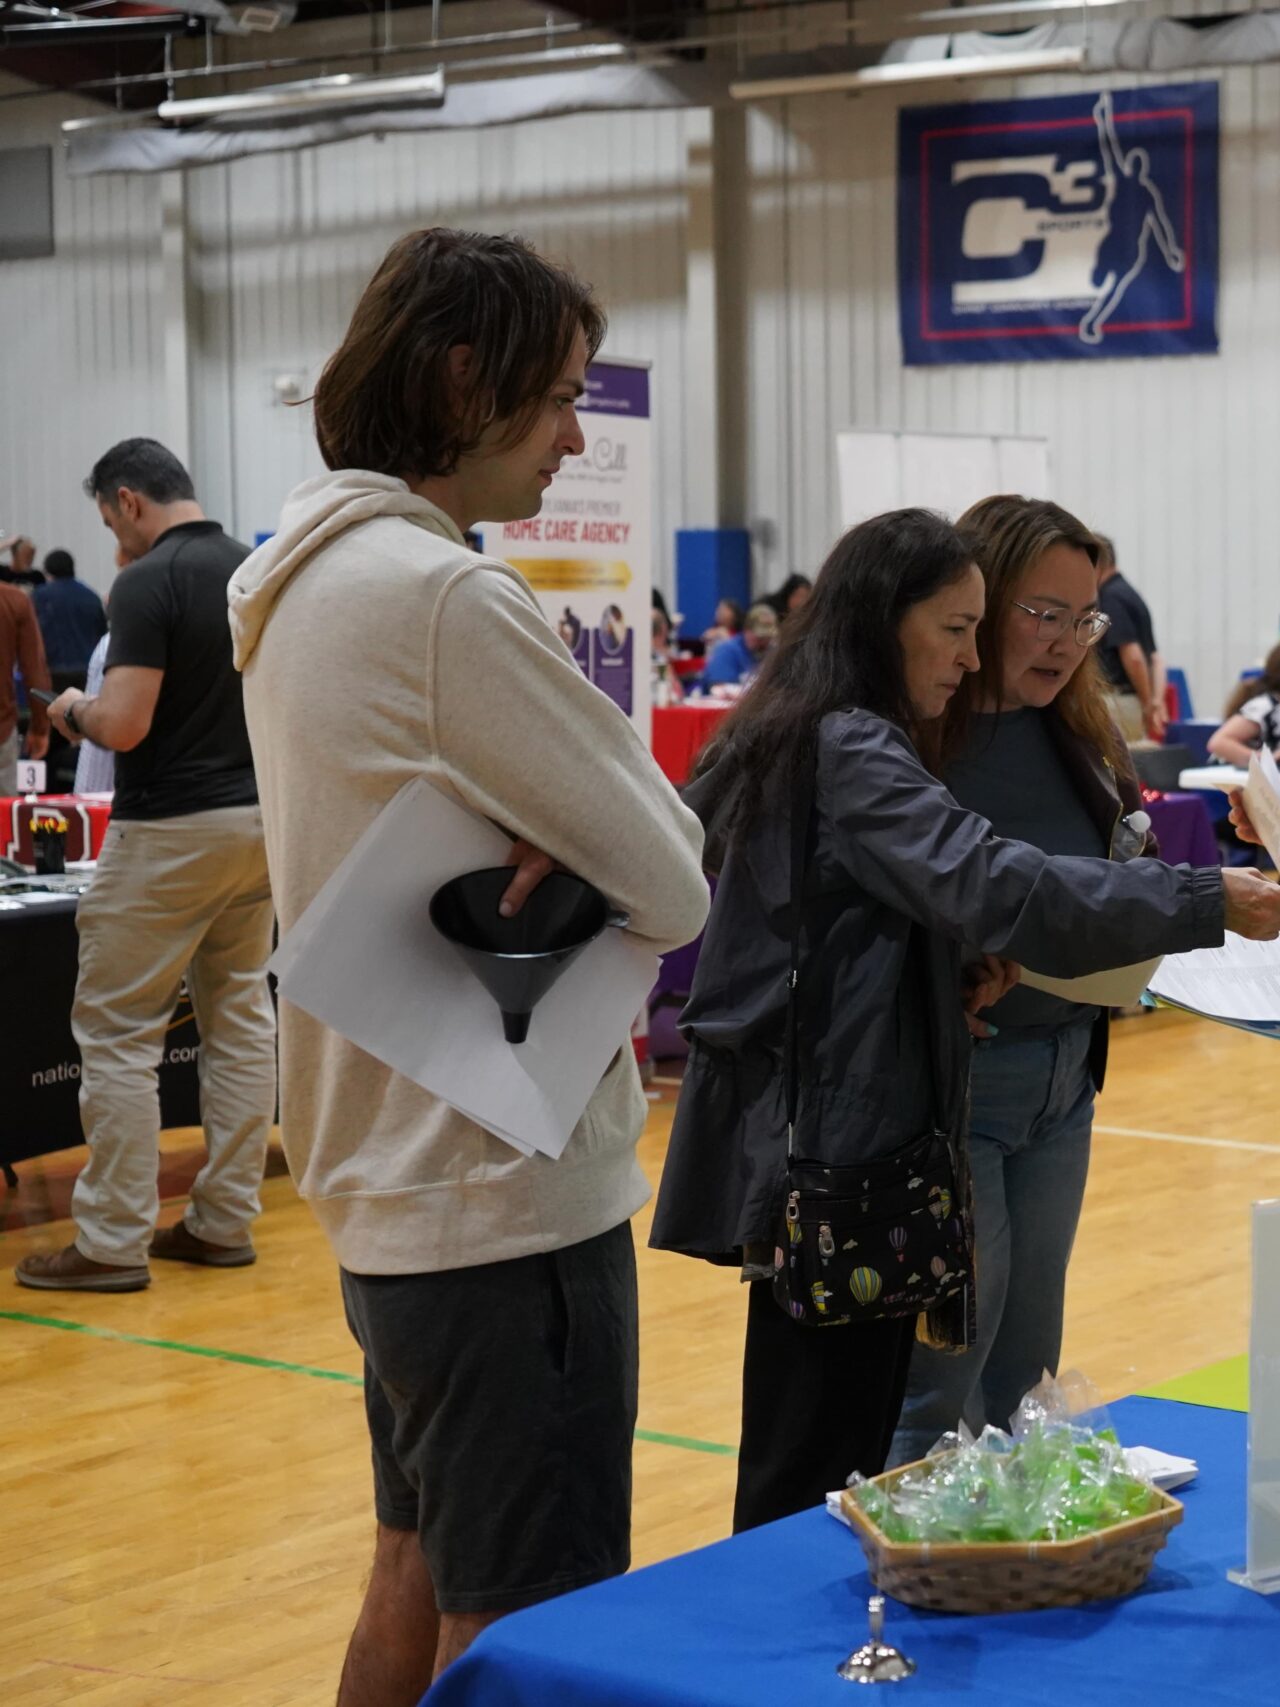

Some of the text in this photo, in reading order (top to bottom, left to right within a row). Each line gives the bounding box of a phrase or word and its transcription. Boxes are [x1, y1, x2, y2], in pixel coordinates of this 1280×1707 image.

[503, 518, 630, 544] HOME CARE AGENCY
[26, 766, 36, 787] 3
